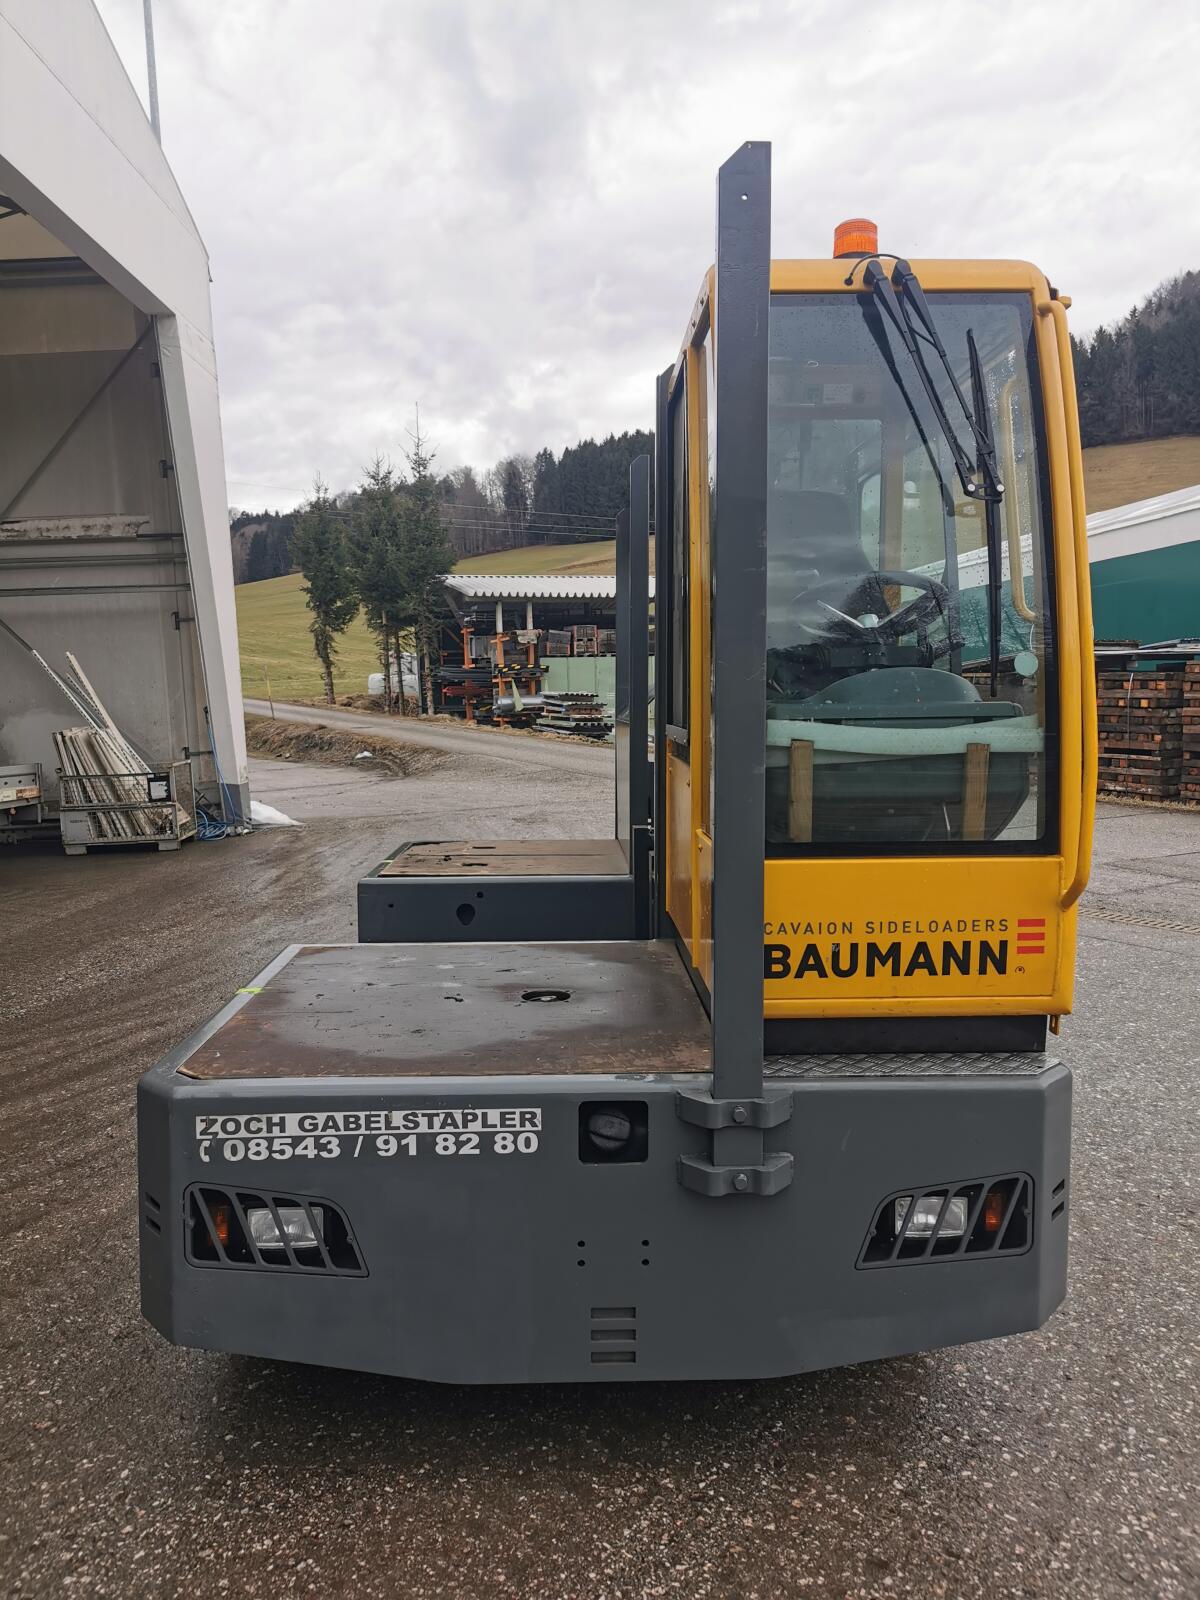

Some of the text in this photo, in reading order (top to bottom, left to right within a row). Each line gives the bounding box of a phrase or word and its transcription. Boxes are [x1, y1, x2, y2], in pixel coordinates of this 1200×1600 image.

[763, 919, 1009, 936] CAVAION SIDELOADERS
[763, 940, 1008, 979] BAUMANN
[200, 1111, 539, 1136] ZOCH GABELSTAPLER
[223, 1132, 539, 1161] 08543 / 91 82 80
